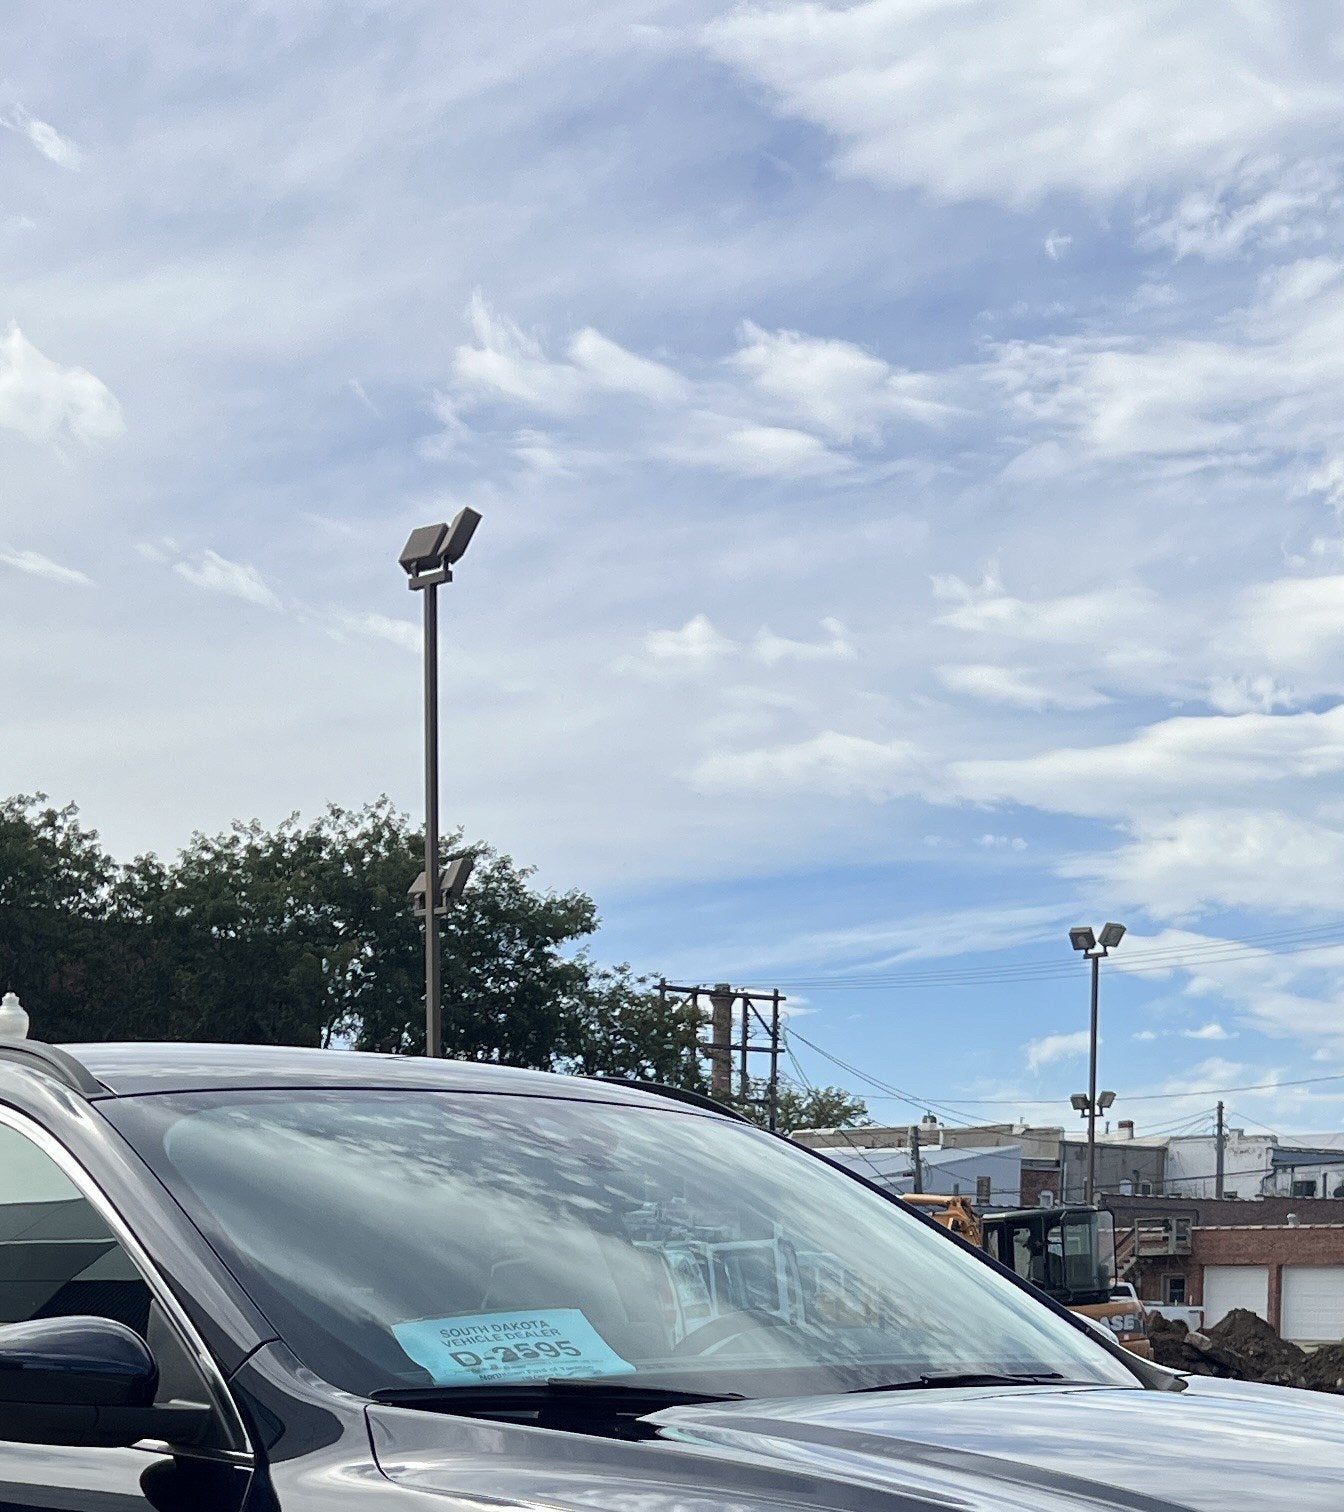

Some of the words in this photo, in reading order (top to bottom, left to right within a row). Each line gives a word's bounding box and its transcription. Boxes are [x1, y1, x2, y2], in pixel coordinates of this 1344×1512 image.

[439, 1324, 489, 1340] SOUTH
[492, 1319, 551, 1333] DAKOTA
[1099, 1314, 1135, 1331] ASE
[441, 1333, 505, 1349] VEHICLE
[505, 1328, 562, 1341] DEALER
